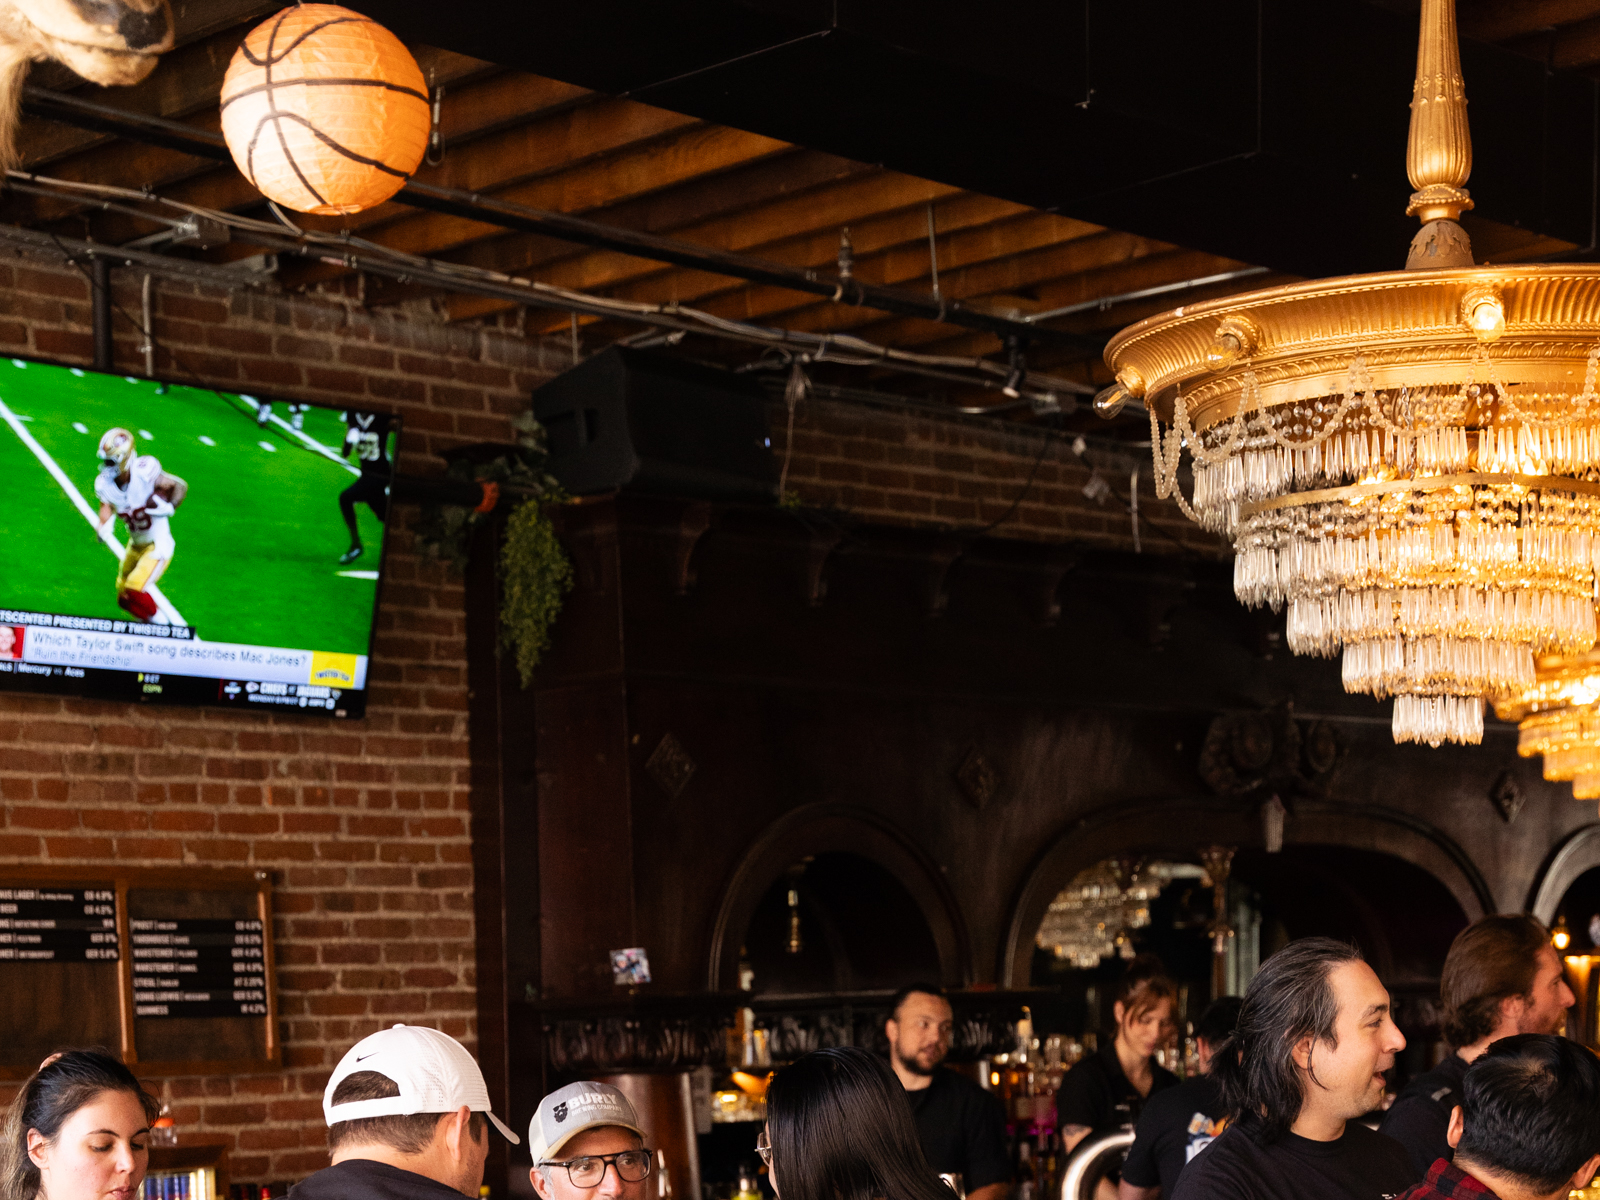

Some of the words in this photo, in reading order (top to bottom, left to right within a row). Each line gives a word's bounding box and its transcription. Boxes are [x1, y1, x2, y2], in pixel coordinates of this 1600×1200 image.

[54, 615, 112, 631] PRESENTED
[113, 621, 127, 633] BY
[128, 622, 170, 637] TWISTED
[171, 626, 190, 639] TEA
[33, 632, 72, 647] Which
[76, 635, 111, 652] Taylor
[115, 639, 145, 653] Swift
[147, 645, 177, 660] song
[180, 645, 237, 662] describes
[239, 650, 266, 664] Mac
[268, 653, 308, 668] Jones?
[60, 649, 76, 661] the
[17, 663, 52, 677] Mercury
[568, 1093, 617, 1110] BURLY
[571, 1104, 597, 1117] BREWING
